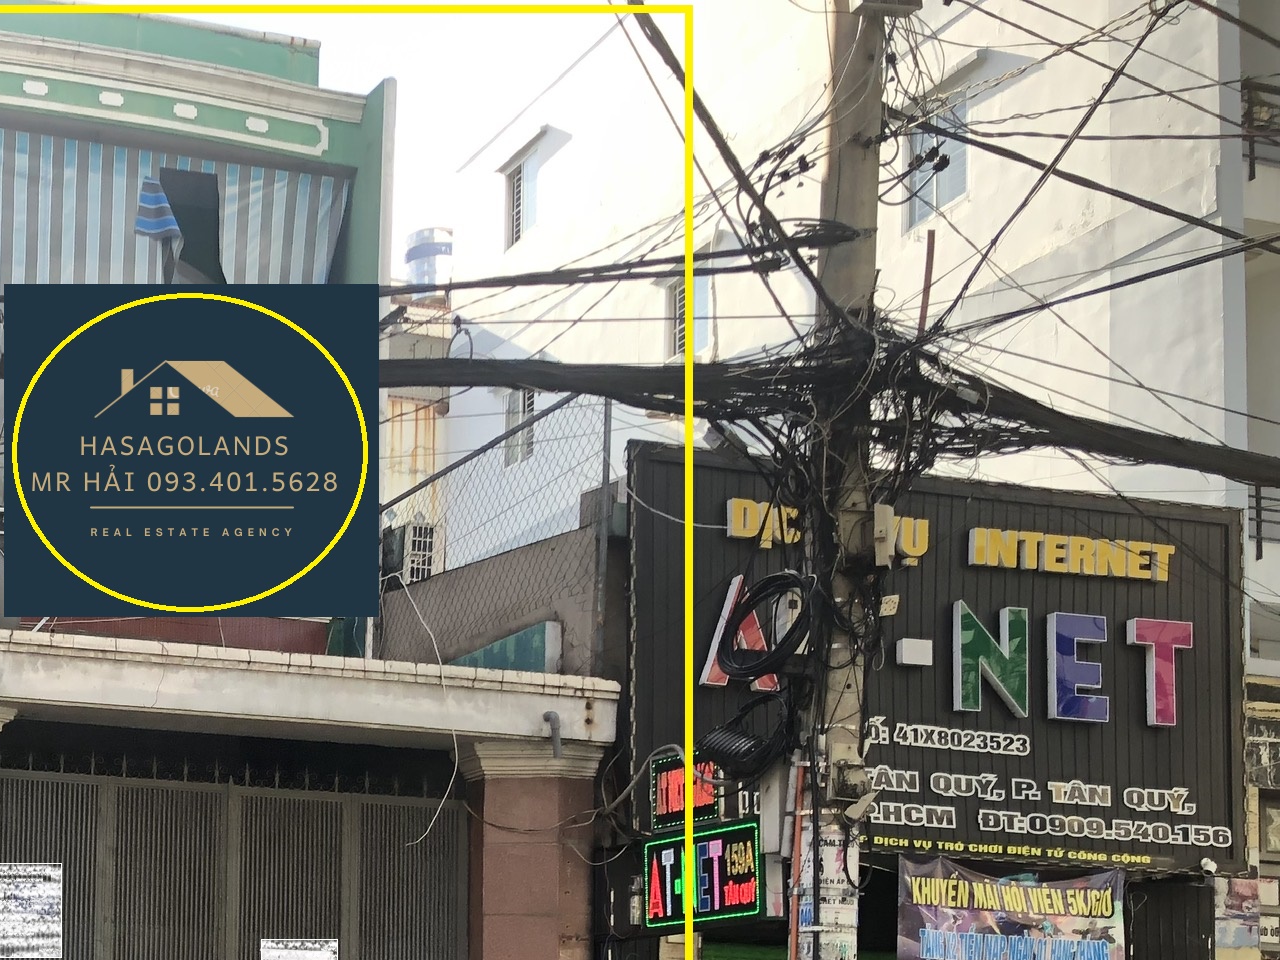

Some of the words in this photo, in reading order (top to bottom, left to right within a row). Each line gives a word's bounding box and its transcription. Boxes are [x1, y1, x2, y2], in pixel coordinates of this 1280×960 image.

[969, 527, 1176, 582] INTERNET
[894, 722, 1031, 756] 41X8023523
[930, 772, 1006, 802] QUÝ,
[1011, 777, 1042, 801] P.
[1047, 780, 1112, 807] TÂN
[1123, 786, 1197, 816] QUÝ,
[724, 840, 755, 877] 159A
[874, 836, 909, 847] DỊCH
[913, 839, 933, 850] VỤ
[911, 870, 969, 908] KHUYẾN
[1001, 881, 1028, 917] HỘI
[1028, 882, 1066, 914] VIÊN
